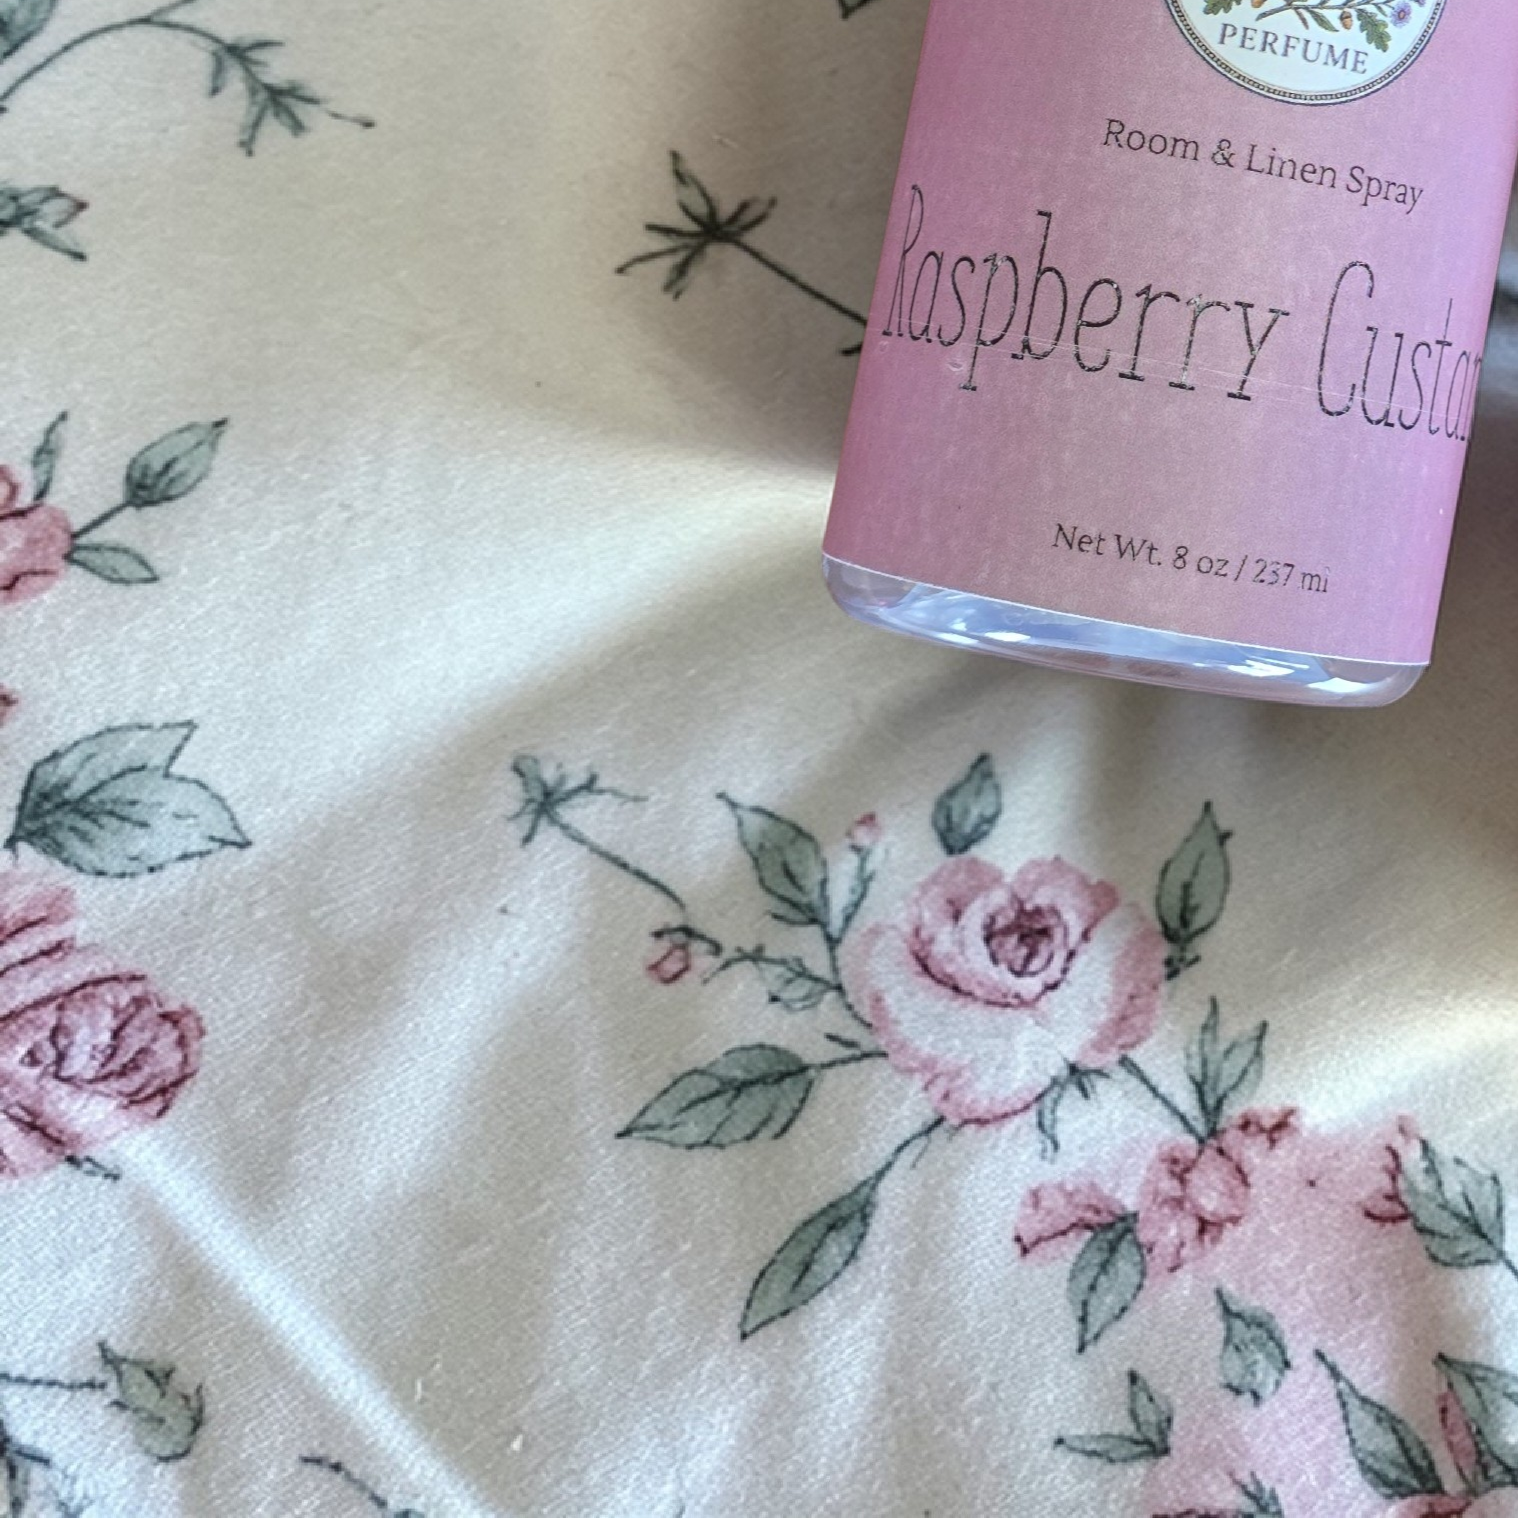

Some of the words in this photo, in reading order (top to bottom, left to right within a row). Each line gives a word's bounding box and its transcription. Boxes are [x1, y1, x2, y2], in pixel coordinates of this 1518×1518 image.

[1217, 23, 1369, 75] PERFUME
[1103, 117, 1199, 161] Room
[1210, 138, 1236, 168] &
[1245, 143, 1338, 189] Linen
[1345, 165, 1424, 215] Spray
[881, 184, 1291, 401] Raspberry
[1051, 522, 1106, 556] Net
[1113, 533, 1163, 567] Wt.
[1172, 545, 1189, 570] 8
[1196, 555, 1230, 578] oz
[1233, 554, 1249, 582] /
[1252, 557, 1297, 587] 237
